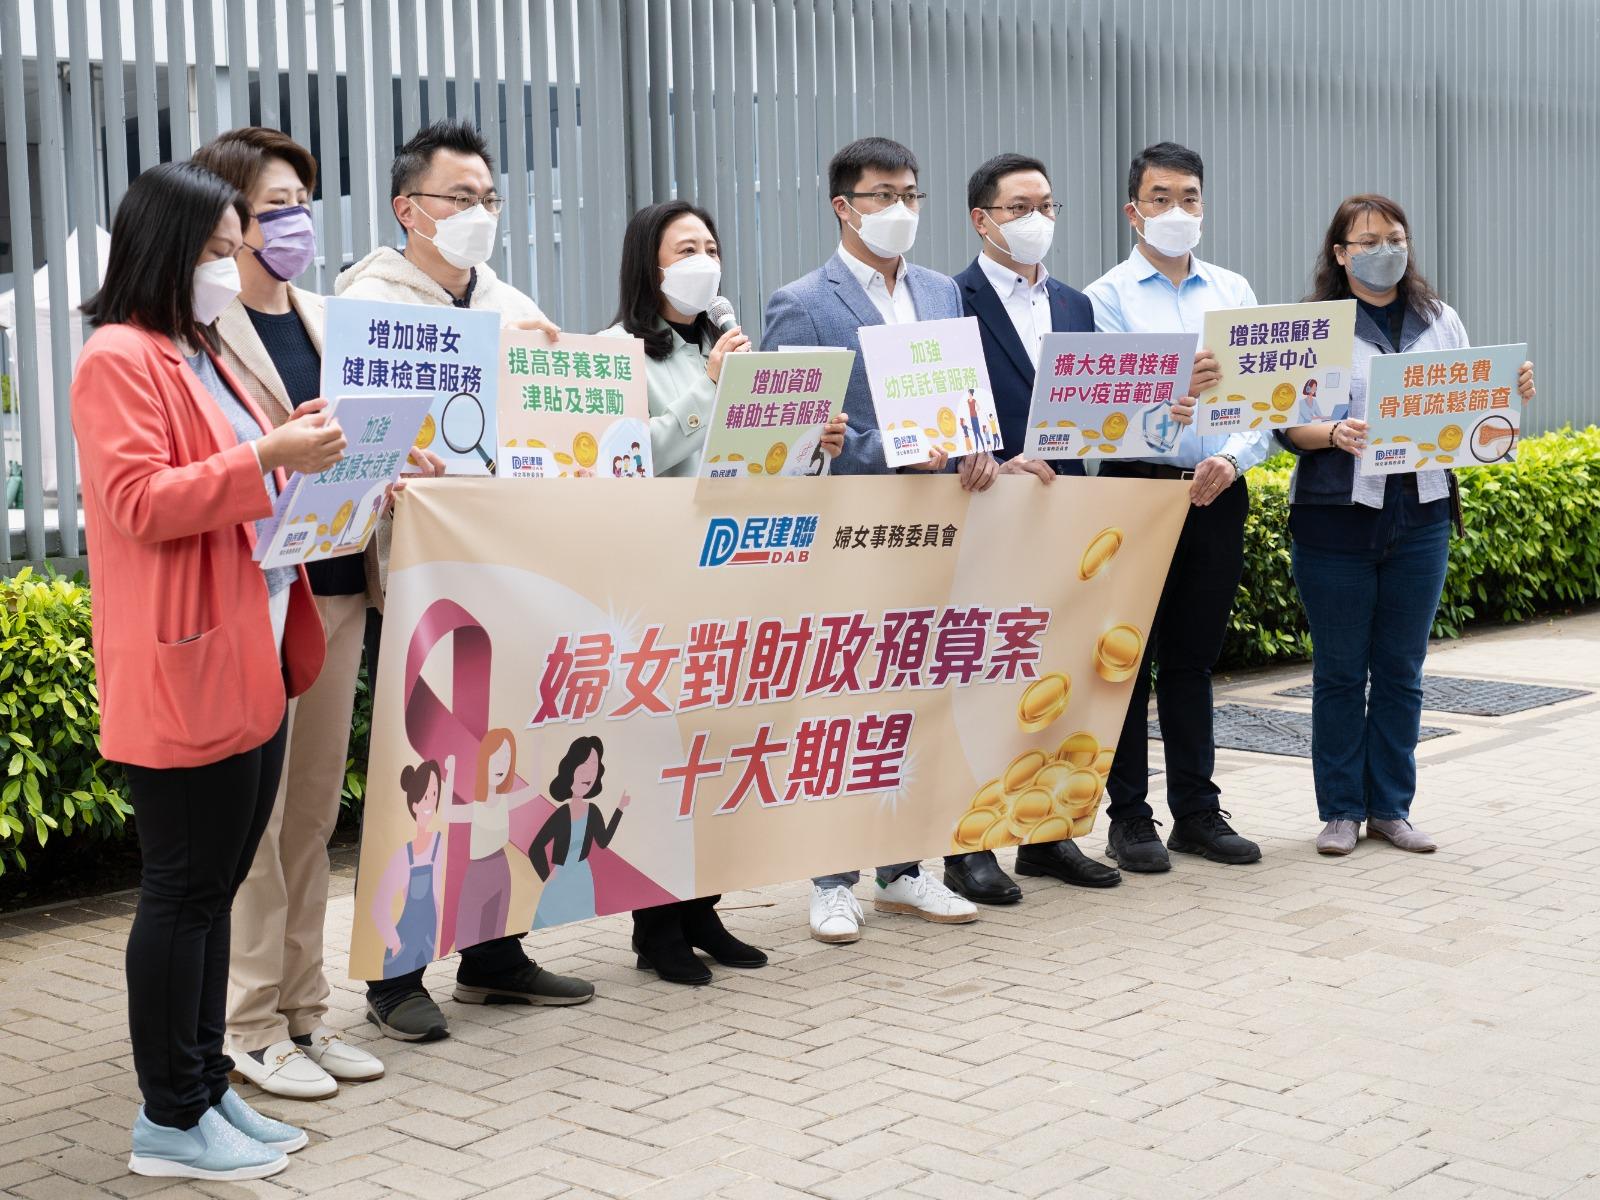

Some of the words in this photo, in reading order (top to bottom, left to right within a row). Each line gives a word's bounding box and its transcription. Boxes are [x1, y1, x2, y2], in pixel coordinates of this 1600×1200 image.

[368, 318, 461, 354] 增加婦女
[1229, 318, 1331, 348] 增設照顧者
[508, 348, 632, 381] 提高寄養家庭
[909, 338, 943, 365] 加強
[1054, 352, 1180, 377] 擴大免費接種
[1238, 348, 1318, 376] 支援中心
[342, 356, 483, 394] 健康檢查服務
[751, 367, 823, 395] 增加資助
[884, 366, 979, 399] 幼兒託管服務
[1403, 359, 1492, 387] 提供免費
[1048, 382, 1173, 405] HPV疫苗範圍
[1379, 386, 1512, 418] 骨質疏鬆篩查
[725, 399, 832, 429] 輔助生育服務
[740, 516, 818, 550] 民建聯
[833, 523, 958, 550] 婦女事務委員會
[771, 550, 811, 565] DAB
[530, 605, 1050, 725] 婦女對財政預算案
[660, 713, 912, 818] 十大期望
